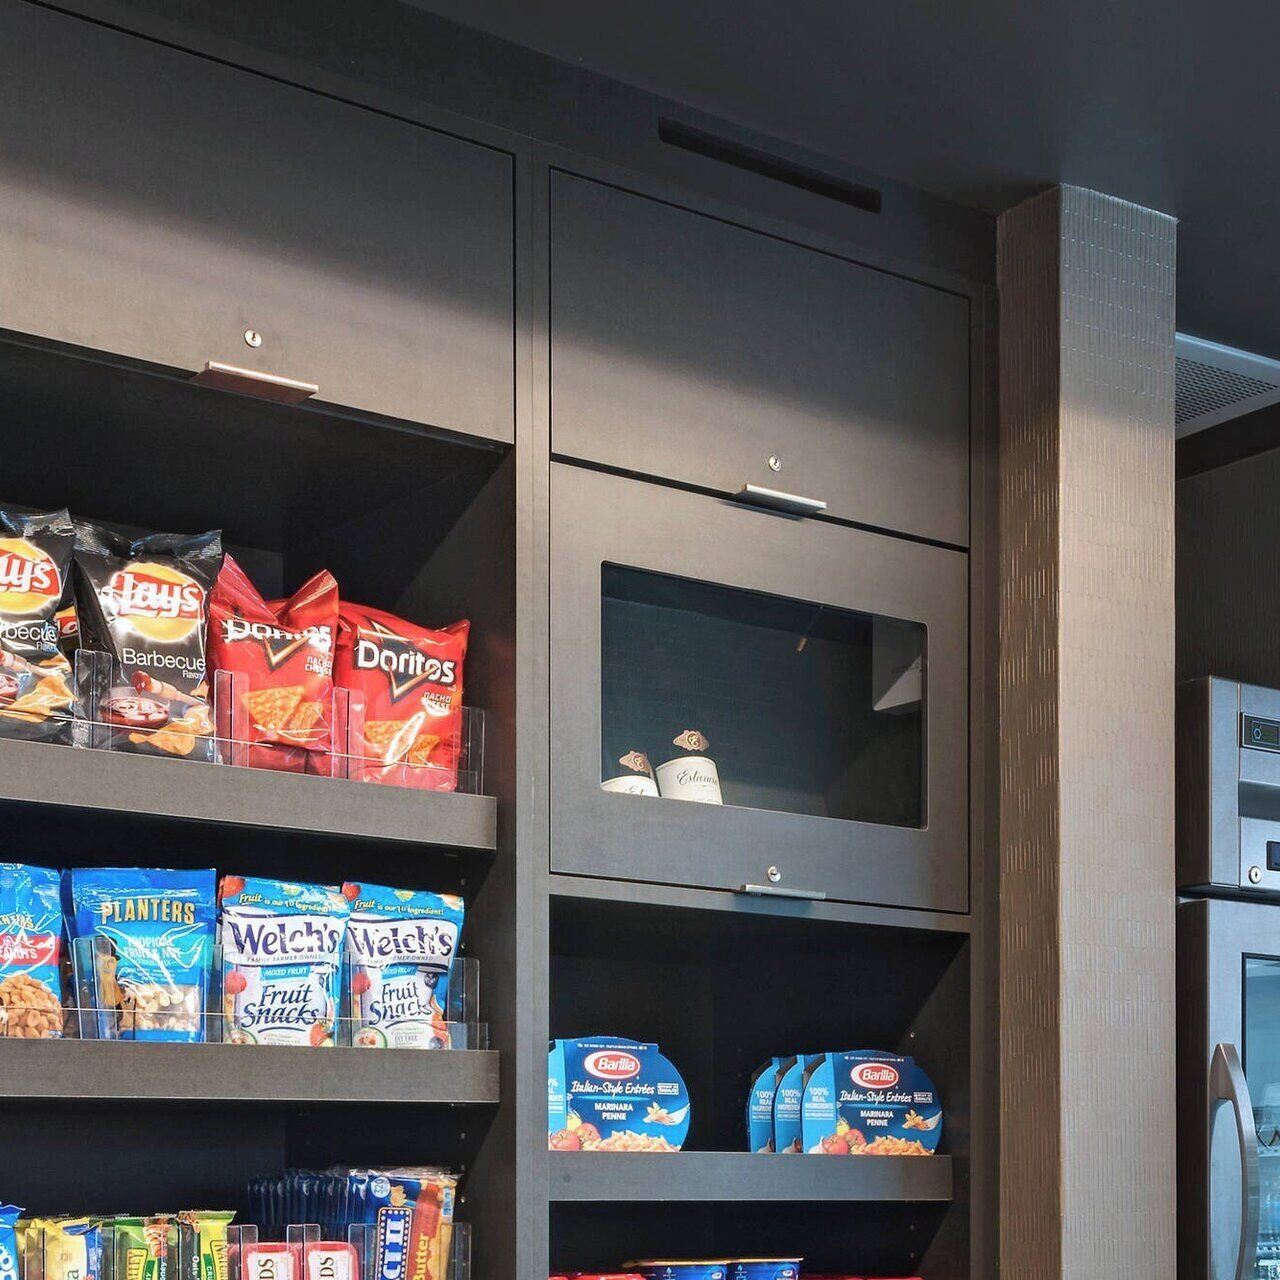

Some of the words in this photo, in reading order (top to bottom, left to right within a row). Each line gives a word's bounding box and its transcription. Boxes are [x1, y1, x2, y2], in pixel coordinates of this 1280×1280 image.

[120, 573, 200, 619] Lay's
[122, 648, 206, 672] Barbecue
[357, 640, 455, 683] Doritos
[423, 692, 452, 703] NACHO
[238, 894, 263, 905] Fruit
[354, 900, 375, 911] Fruit
[407, 906, 444, 916] Ingredient!
[101, 898, 196, 925] PLANTERS
[228, 921, 340, 955] Welch's
[346, 925, 452, 957] Welch's
[258, 982, 313, 1007] Fruit
[381, 981, 420, 1001] Fruit
[240, 1002, 320, 1028] Snacks
[369, 1000, 432, 1026] Snacks
[598, 1057, 635, 1071] Barilla
[862, 1069, 895, 1082] Barilla
[571, 1080, 624, 1097] Italian-Style
[625, 1081, 655, 1095] Entrées
[781, 1089, 801, 1098] 100%
[839, 1090, 885, 1105] Italian-Style
[886, 1091, 912, 1103] Entrées
[595, 1102, 634, 1111] MARINARA
[860, 1110, 894, 1119] MARINARA
[602, 1112, 627, 1120] PENNE
[866, 1119, 888, 1127] PENNE
[192, 1256, 200, 1273] Oats
